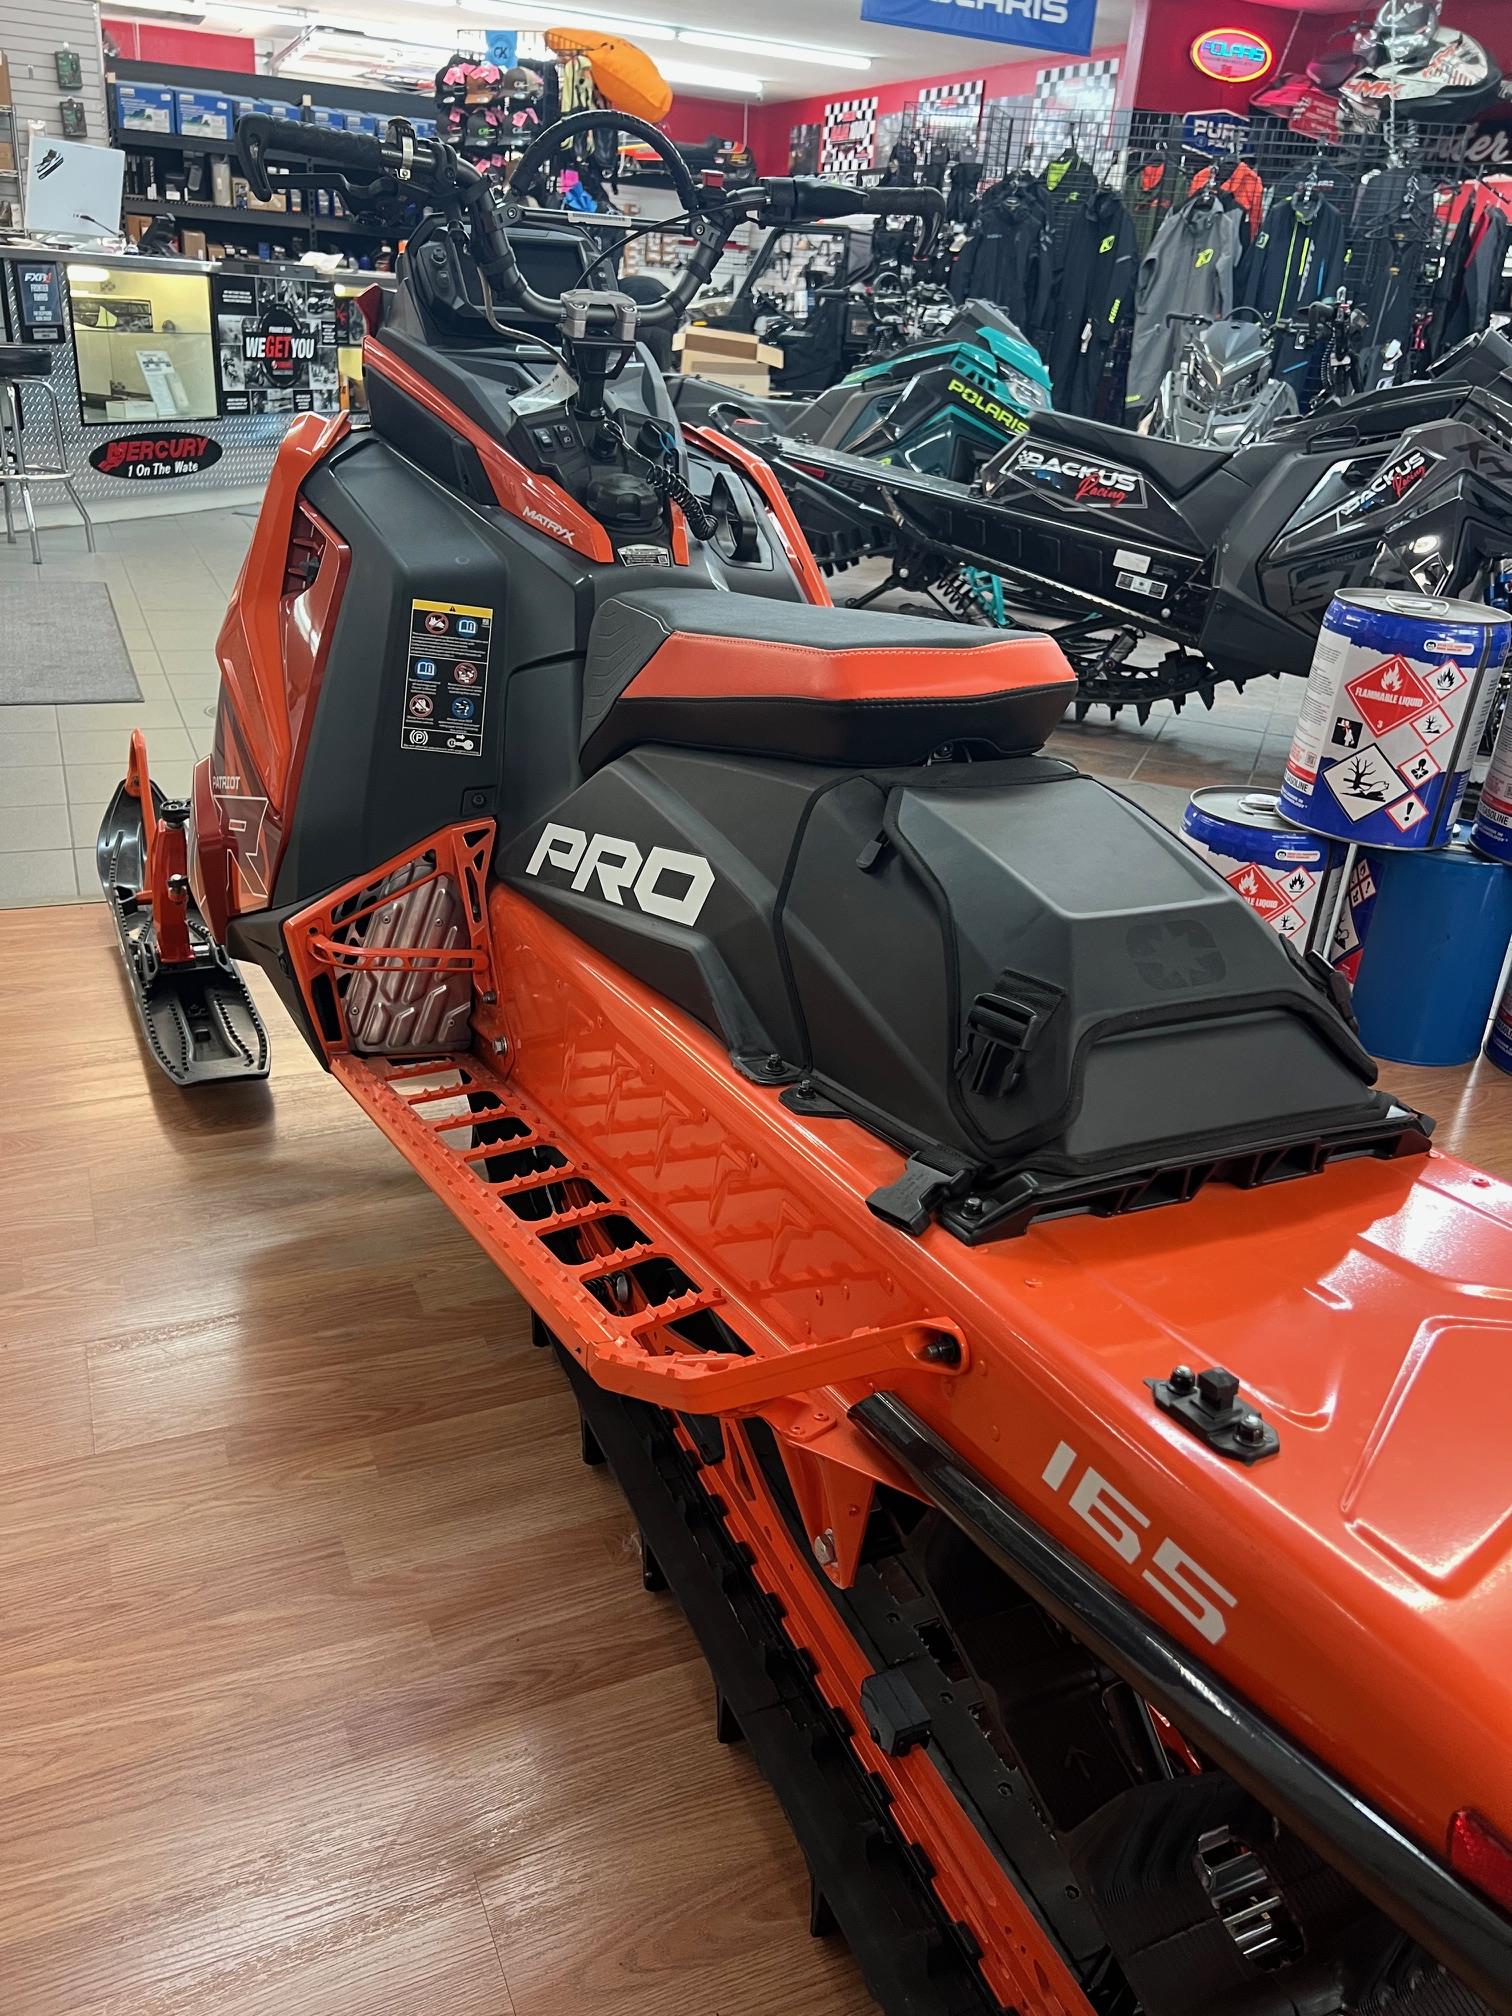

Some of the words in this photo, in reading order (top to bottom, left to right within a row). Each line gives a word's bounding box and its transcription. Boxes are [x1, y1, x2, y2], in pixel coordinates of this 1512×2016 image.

[1201, 40, 1265, 63] POLARIS
[947, 379, 1031, 435] POLARIS
[101, 436, 209, 468] MERCURY
[136, 463, 151, 477] On
[153, 461, 171, 475] The
[174, 460, 199, 474] Wate
[1014, 450, 1138, 492] BACKUS
[1340, 452, 1426, 516] BACKUS
[1391, 465, 1426, 499] Racing
[1074, 473, 1128, 507] Racing
[522, 505, 577, 545] MATRYX
[1355, 686, 1399, 704] FLAMMABLE
[1398, 695, 1424, 708] LIQUID
[1376, 720, 1384, 729] 3
[212, 776, 241, 790] PATRIOT
[525, 822, 716, 927] PRO
[1255, 897, 1278, 910] LIQUID
[1041, 1440, 1238, 1645] 165
